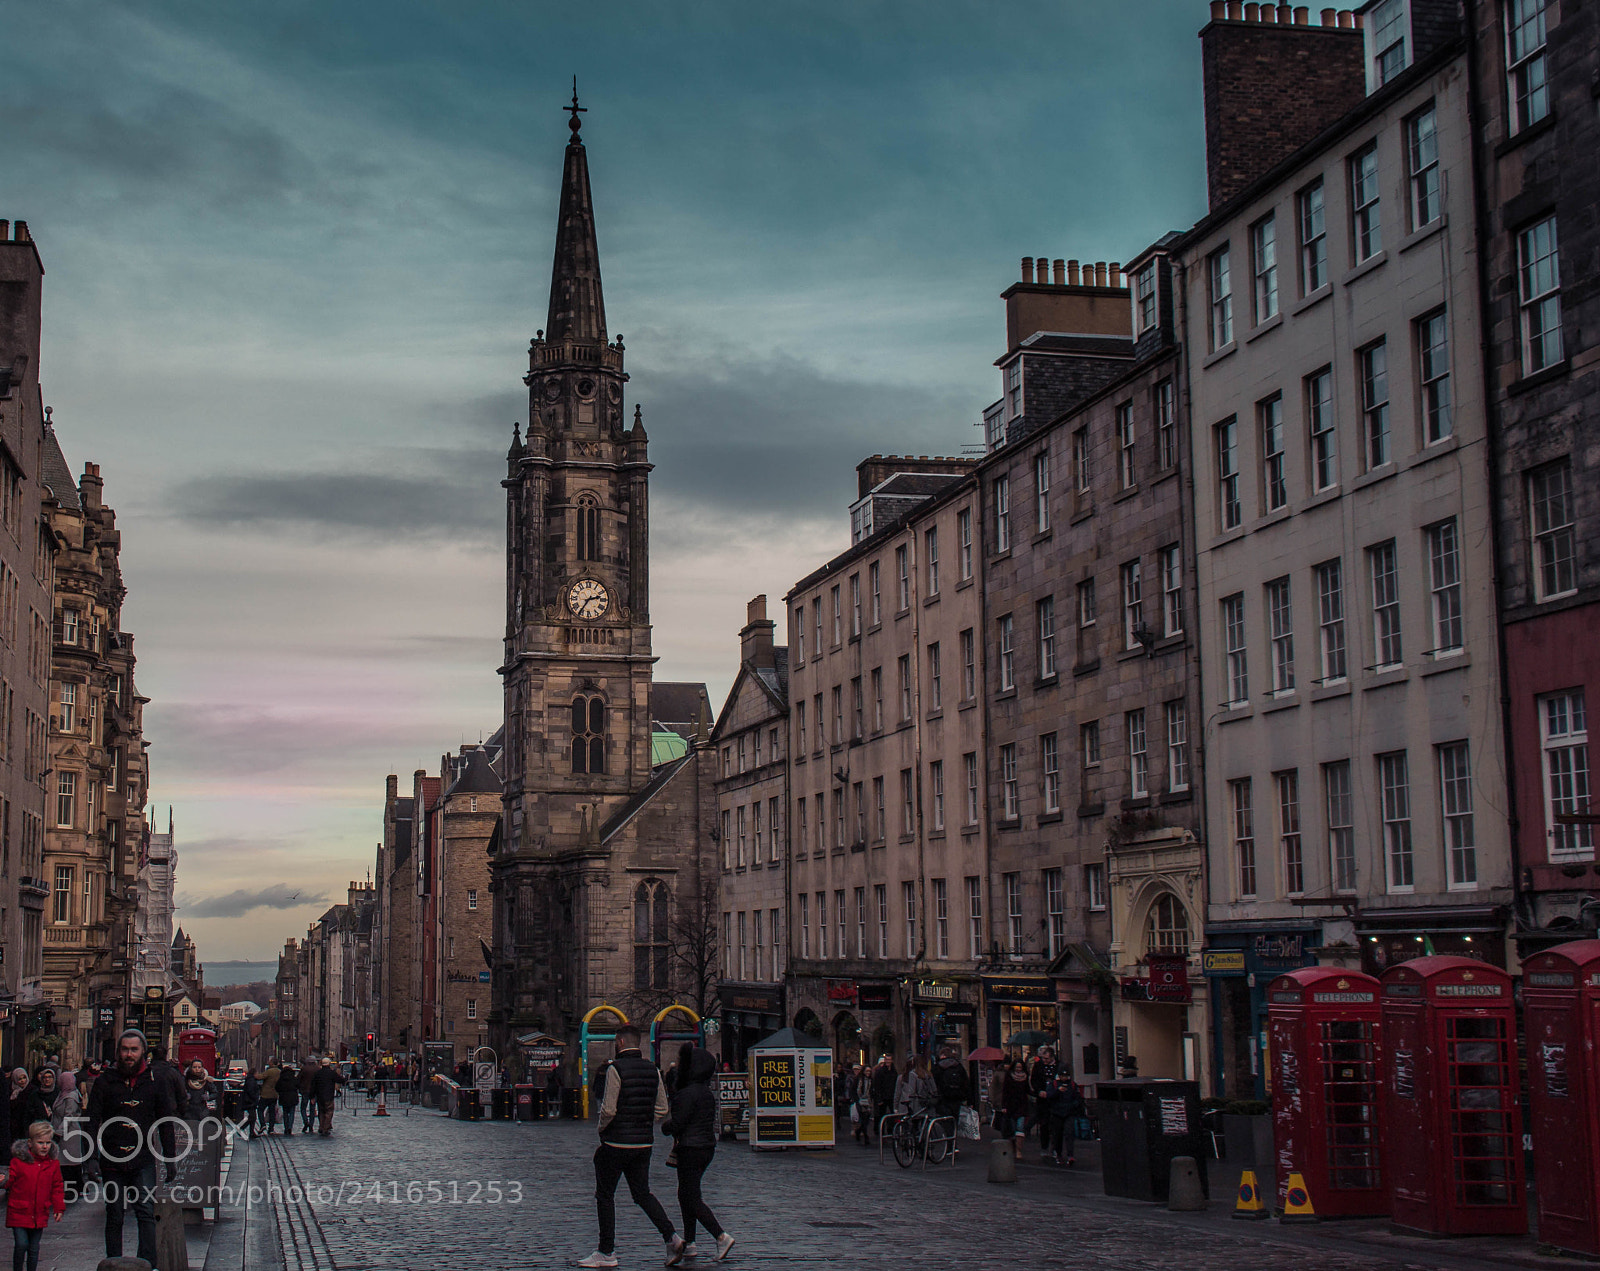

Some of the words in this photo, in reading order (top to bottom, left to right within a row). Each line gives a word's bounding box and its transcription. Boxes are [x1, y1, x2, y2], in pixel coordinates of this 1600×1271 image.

[918, 983, 953, 998] WARHAMMER
[1317, 993, 1371, 1001] TELEPHONE
[763, 1061, 788, 1074] FREE
[720, 1081, 743, 1090] PUB
[759, 1076, 794, 1089] GHOST
[762, 1091, 792, 1103] TOUR
